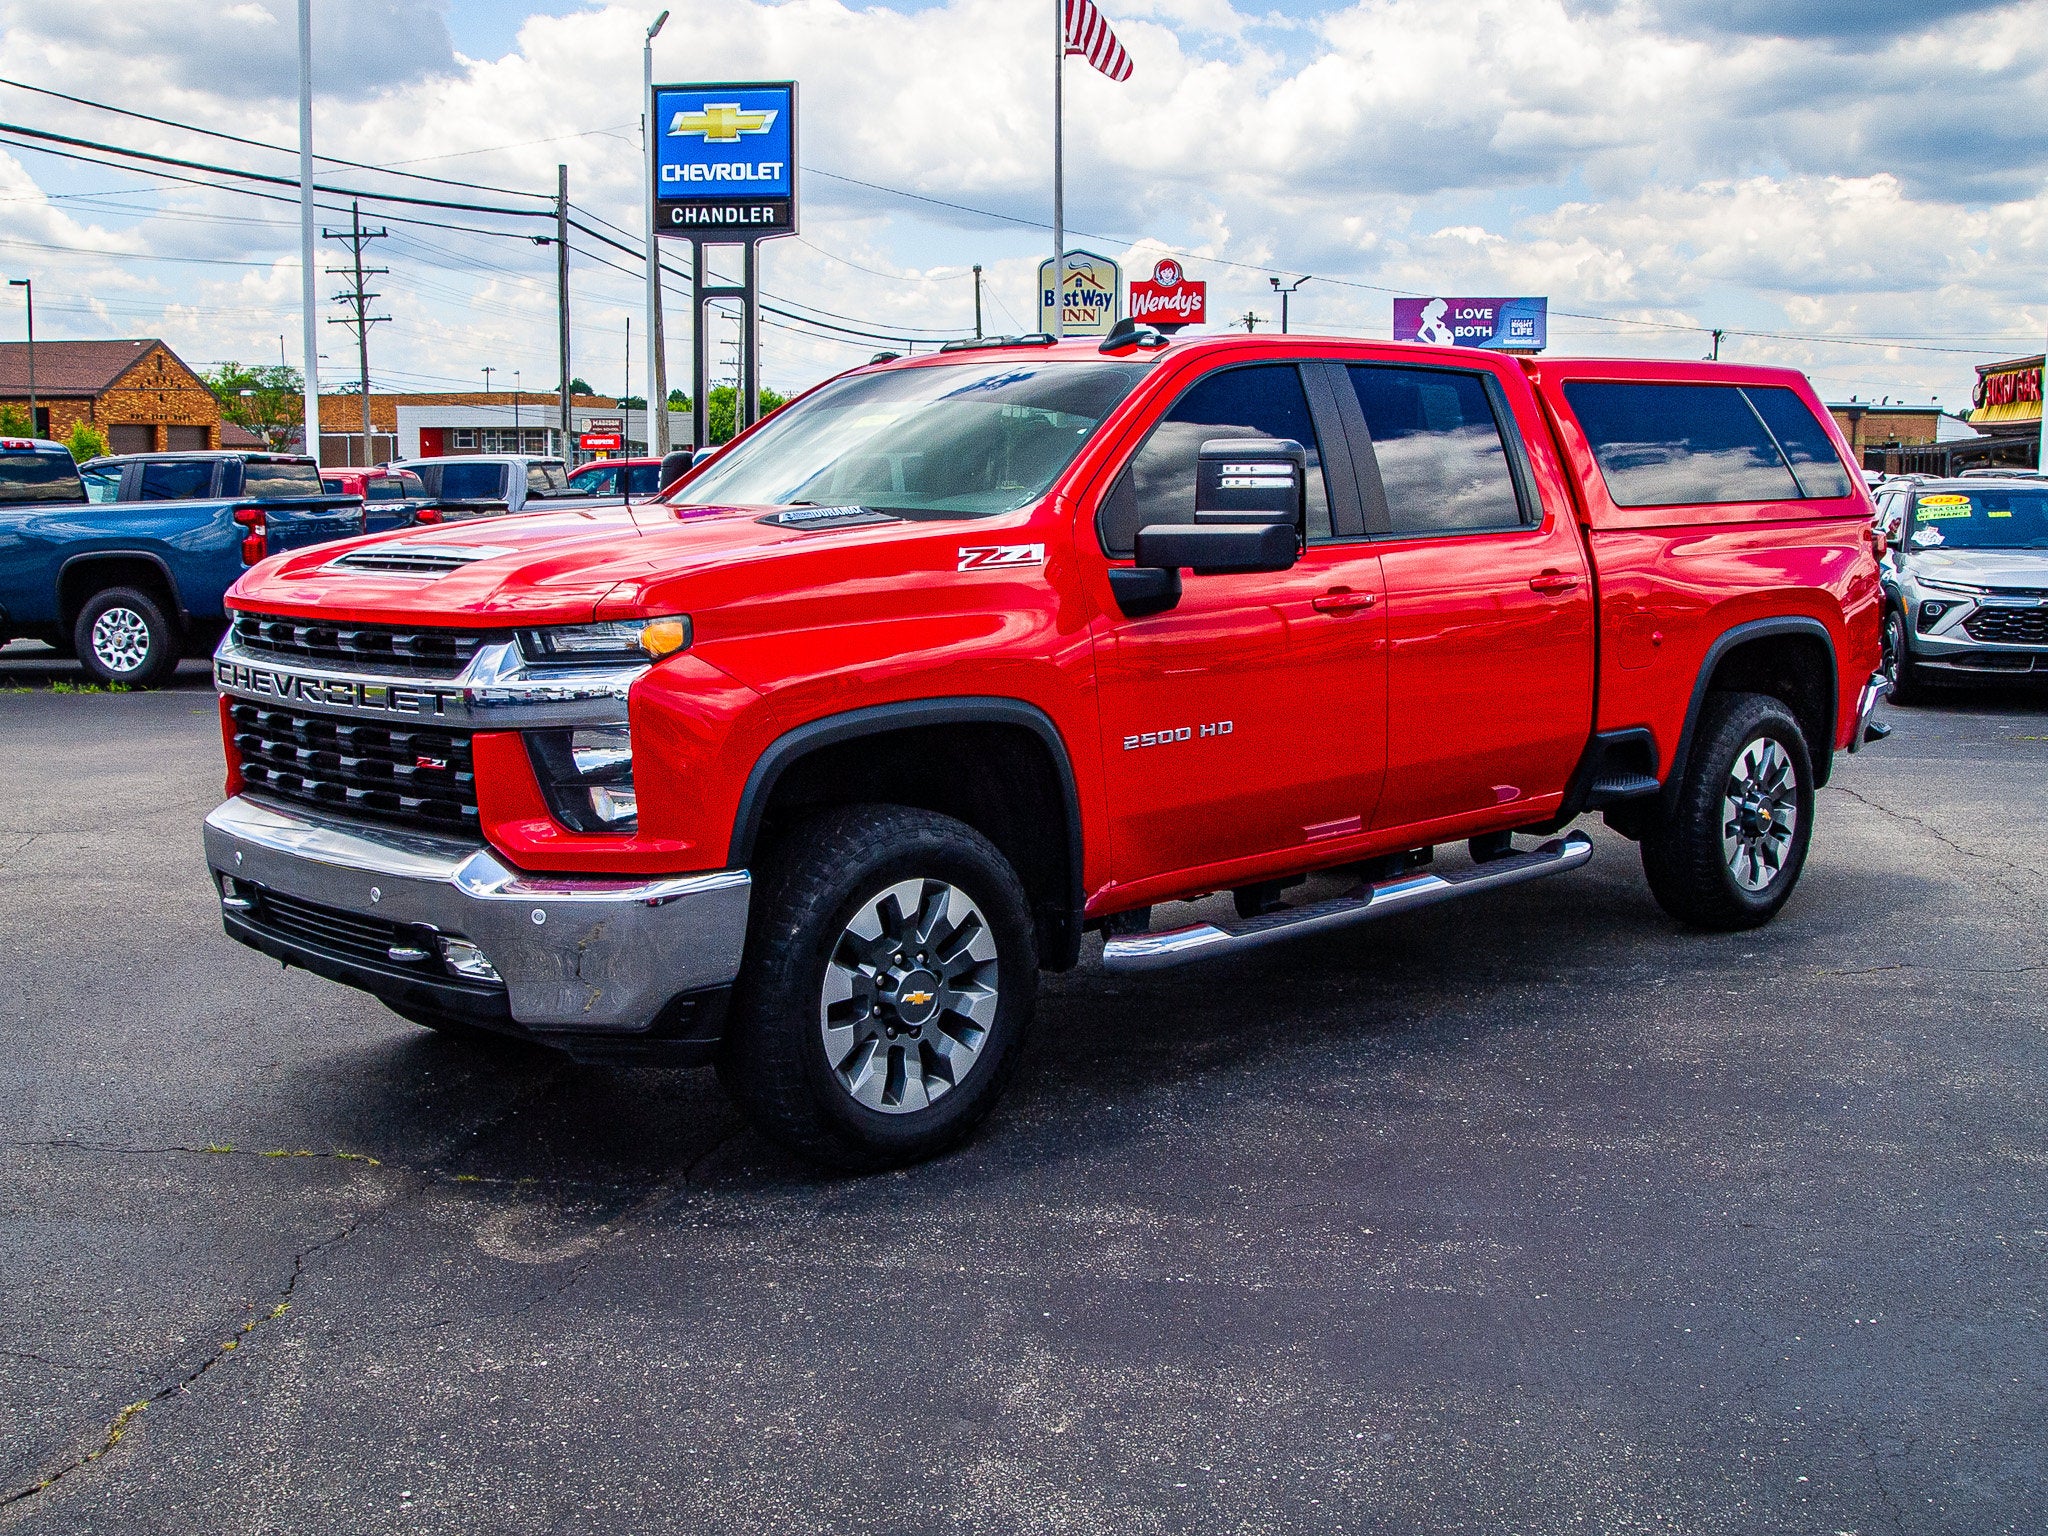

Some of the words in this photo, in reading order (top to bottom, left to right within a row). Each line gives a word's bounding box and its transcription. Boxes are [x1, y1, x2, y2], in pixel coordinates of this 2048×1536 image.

[662, 162, 784, 182] CHEVROLET
[671, 207, 774, 223] CHANDLER
[1044, 289, 1079, 307] Bst
[1081, 289, 1113, 312] Way
[1131, 286, 1202, 318] Wendy's
[1062, 308, 1096, 322] INN
[1455, 308, 1493, 320] LOVE
[1455, 326, 1493, 337] BOTH
[1986, 373, 2016, 406] SUSHI
[957, 543, 1045, 572] Z71
[217, 661, 457, 716] CHEVROLET
[1123, 727, 1191, 751] 2500
[1199, 720, 1233, 738] HD
